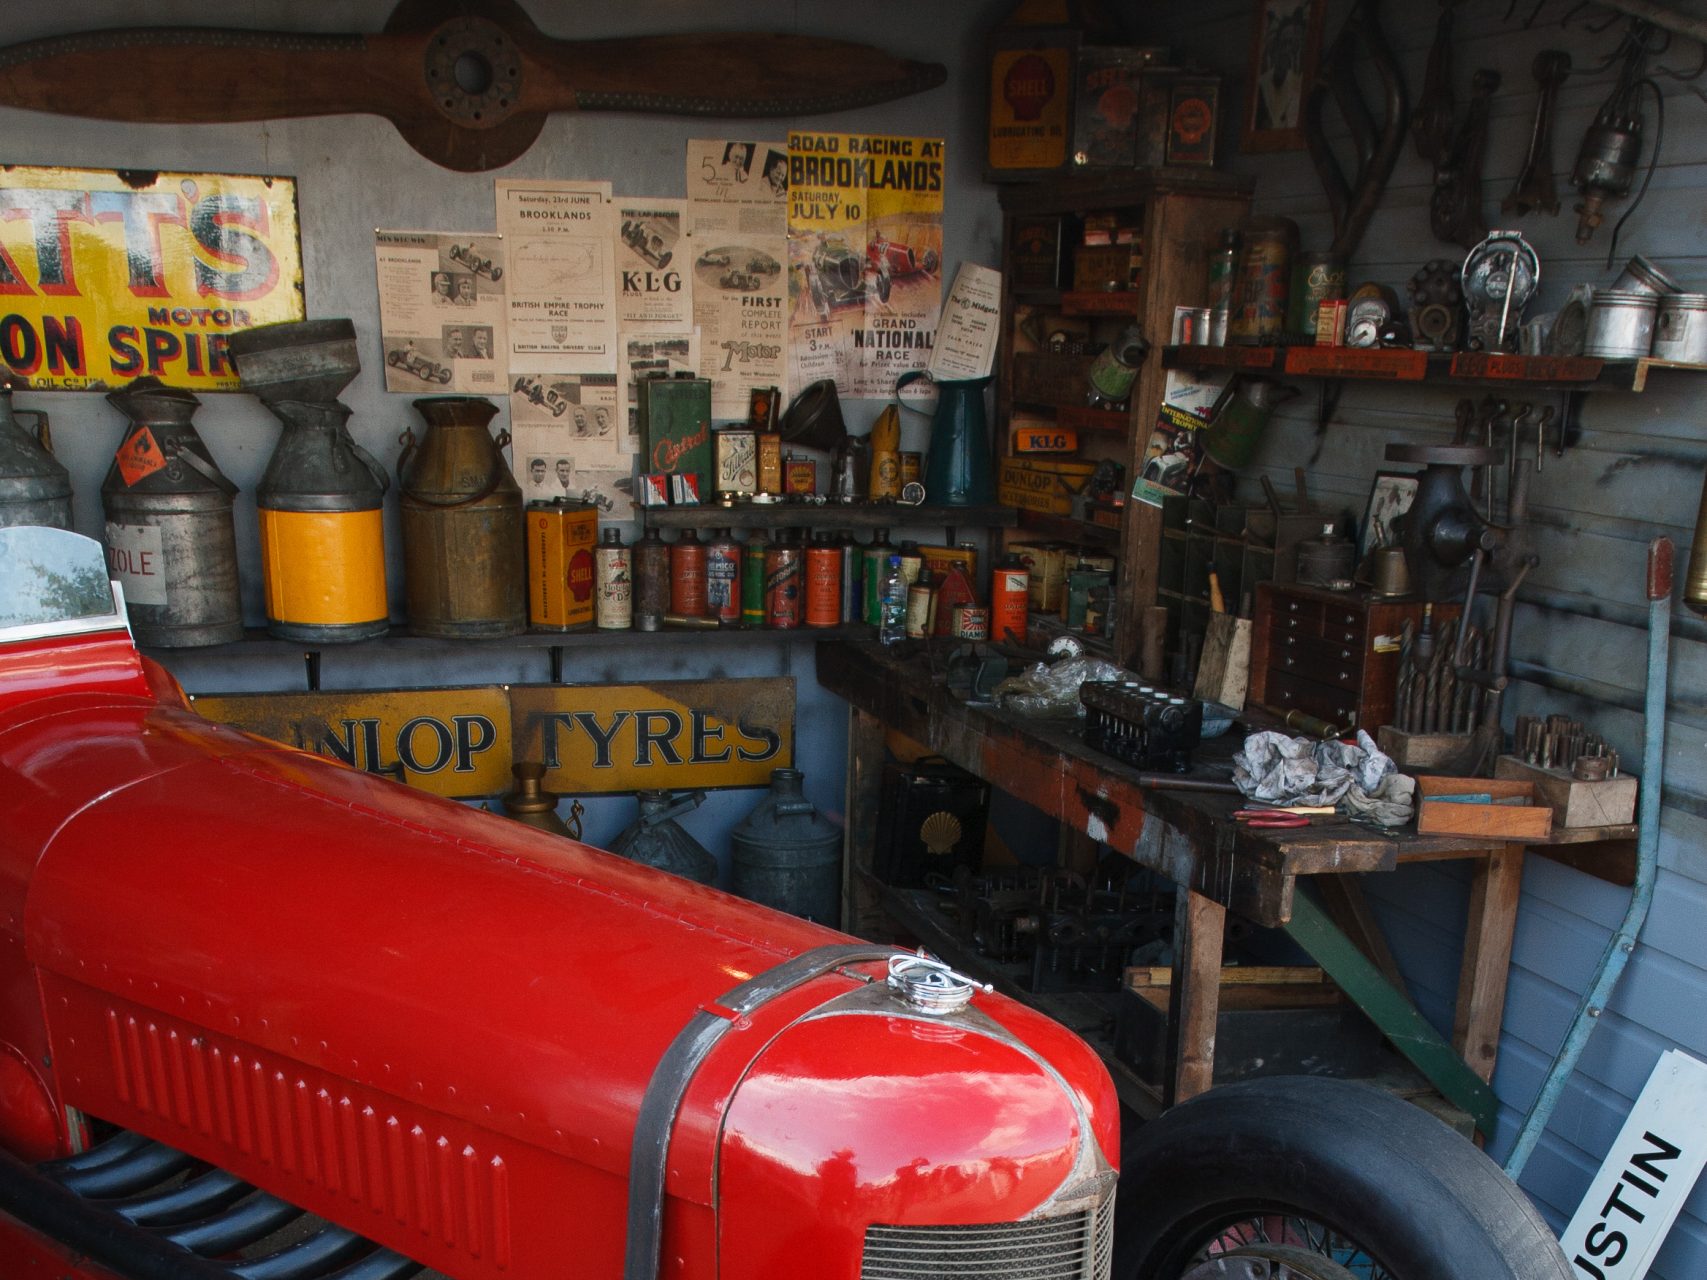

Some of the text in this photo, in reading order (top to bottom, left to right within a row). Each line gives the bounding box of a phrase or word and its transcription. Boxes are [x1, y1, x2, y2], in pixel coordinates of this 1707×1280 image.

[1008, 80, 1048, 97] SHELL
[790, 135, 941, 157] ROAD RACING AT
[790, 155, 941, 191] BROOKLANDS
[519, 195, 551, 204] Saturday,
[571, 196, 591, 204] JUNE
[791, 191, 843, 204] SATURDAY,
[519, 210, 592, 220] BROOKLANDS
[621, 209, 635, 218] THE
[638, 209, 652, 218] LAP
[791, 203, 860, 220] JULY 10
[512, 301, 605, 310] BRITISH EMPIRE TROPHY
[742, 296, 782, 308] FIRST
[148, 307, 252, 327] MOTOR
[741, 309, 782, 319] COMPLETE
[741, 320, 782, 330] REPORT
[873, 319, 916, 329] GRAND
[804, 326, 833, 340] START
[810, 339, 817, 351] 3
[876, 350, 910, 360] RACE
[37, 378, 55, 387] OIL
[1171, 415, 1198, 432] TROPHY
[652, 421, 709, 473] Castrol
[1030, 434, 1067, 449] KLG
[1003, 469, 1051, 490] DUNLOP
[570, 566, 592, 584] SHELL
[294, 709, 782, 775] NLOP TYRES
